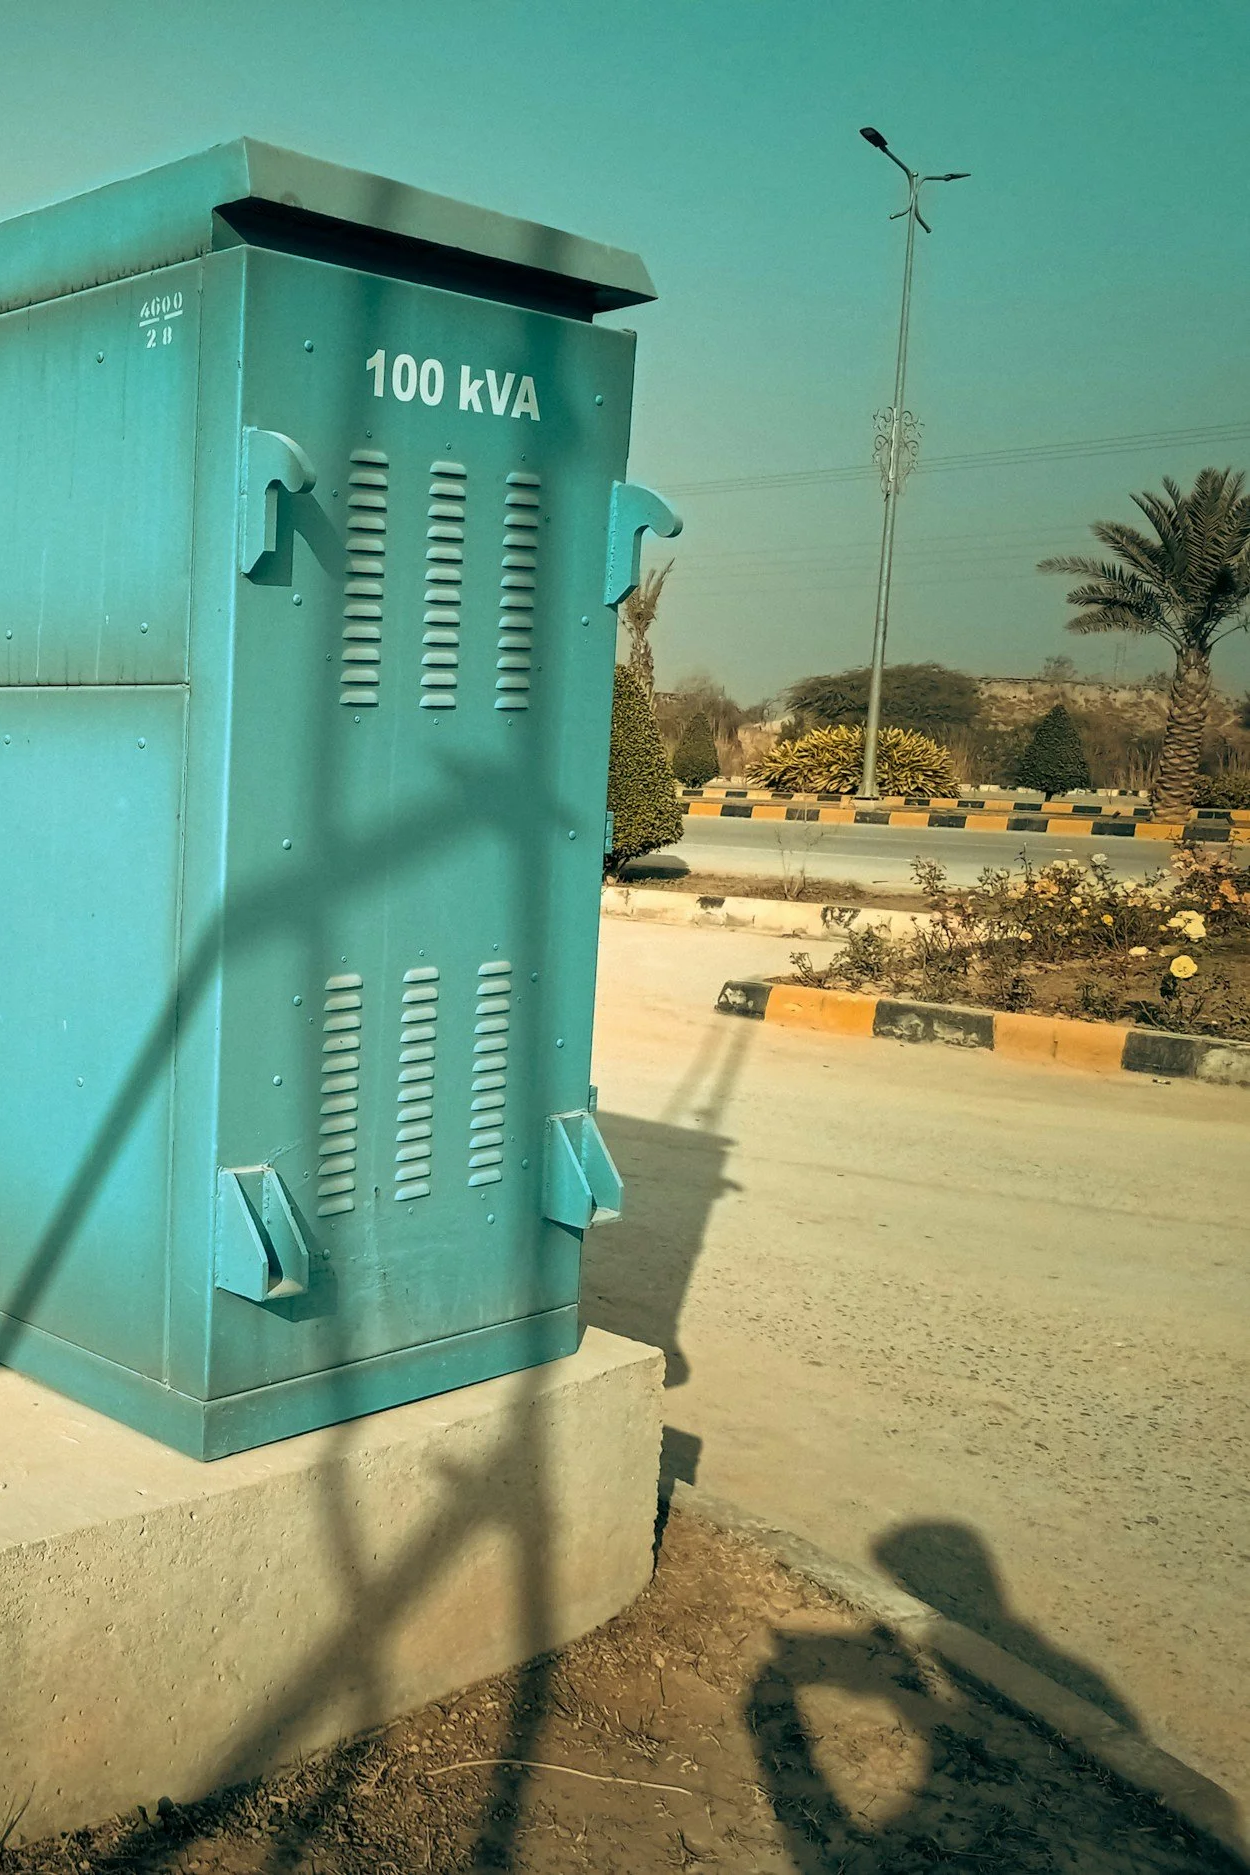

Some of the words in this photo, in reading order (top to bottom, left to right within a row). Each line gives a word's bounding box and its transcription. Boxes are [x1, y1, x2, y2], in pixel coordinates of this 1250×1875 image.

[139, 291, 183, 319] 4600
[366, 348, 445, 407] 100
[458, 364, 541, 422] kVA
